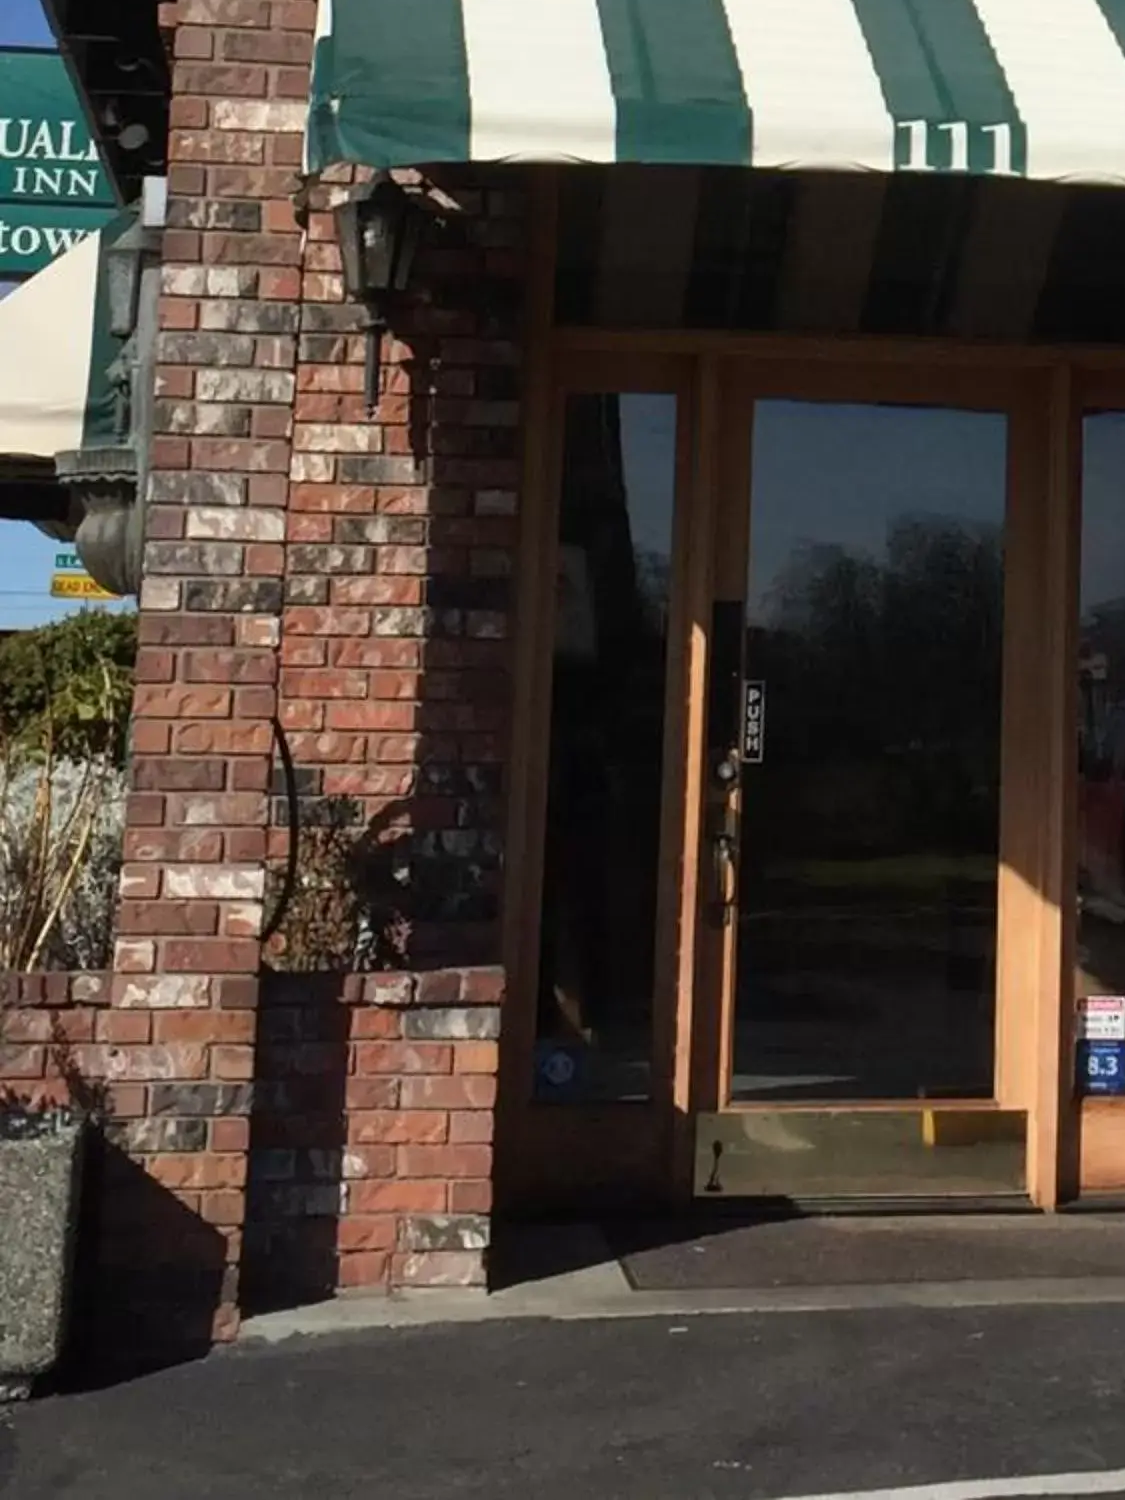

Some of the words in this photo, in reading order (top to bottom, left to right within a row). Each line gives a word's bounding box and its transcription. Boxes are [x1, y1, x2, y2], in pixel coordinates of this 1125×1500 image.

[897, 119, 1022, 177] 111
[12, 166, 99, 196] INN
[746, 688, 760, 751] PUSH
[1087, 1055, 1118, 1076] 8.3
